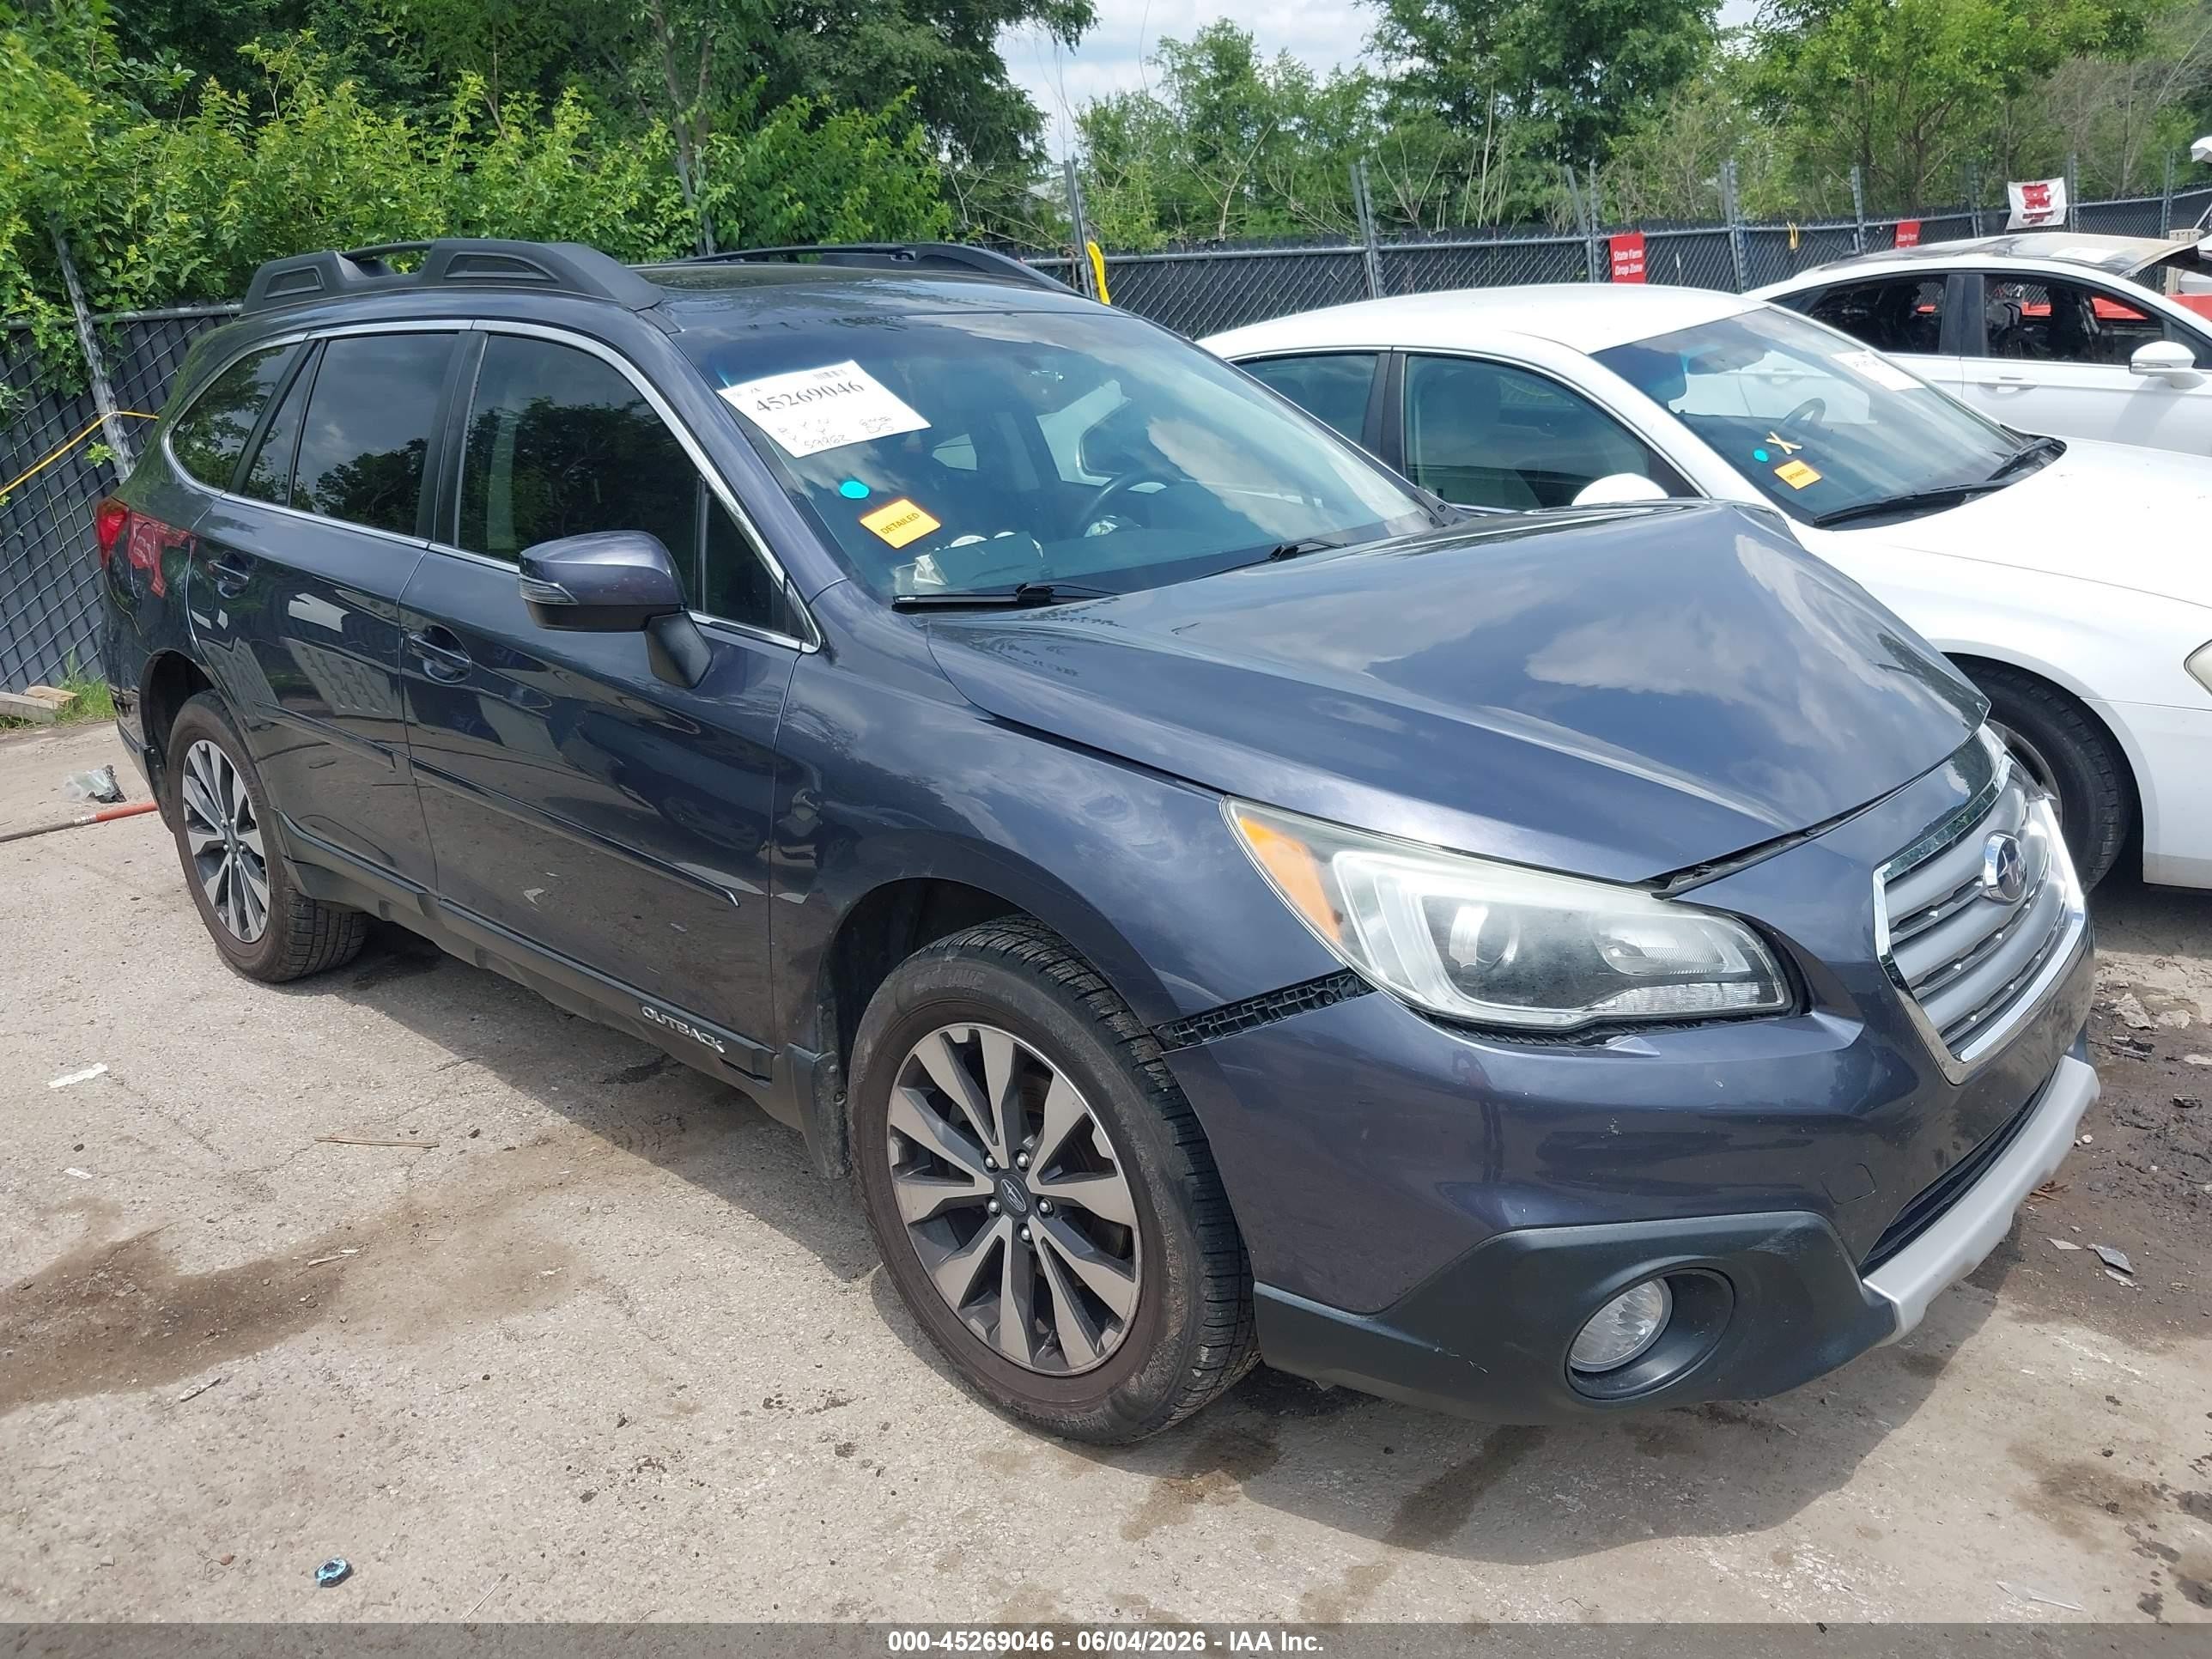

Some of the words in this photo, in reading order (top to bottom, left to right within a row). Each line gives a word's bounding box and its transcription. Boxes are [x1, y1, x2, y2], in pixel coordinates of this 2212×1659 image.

[757, 380, 865, 411] 45269046
[880, 513, 920, 534] DETAILED
[641, 1006, 726, 1054] OUTBACK
